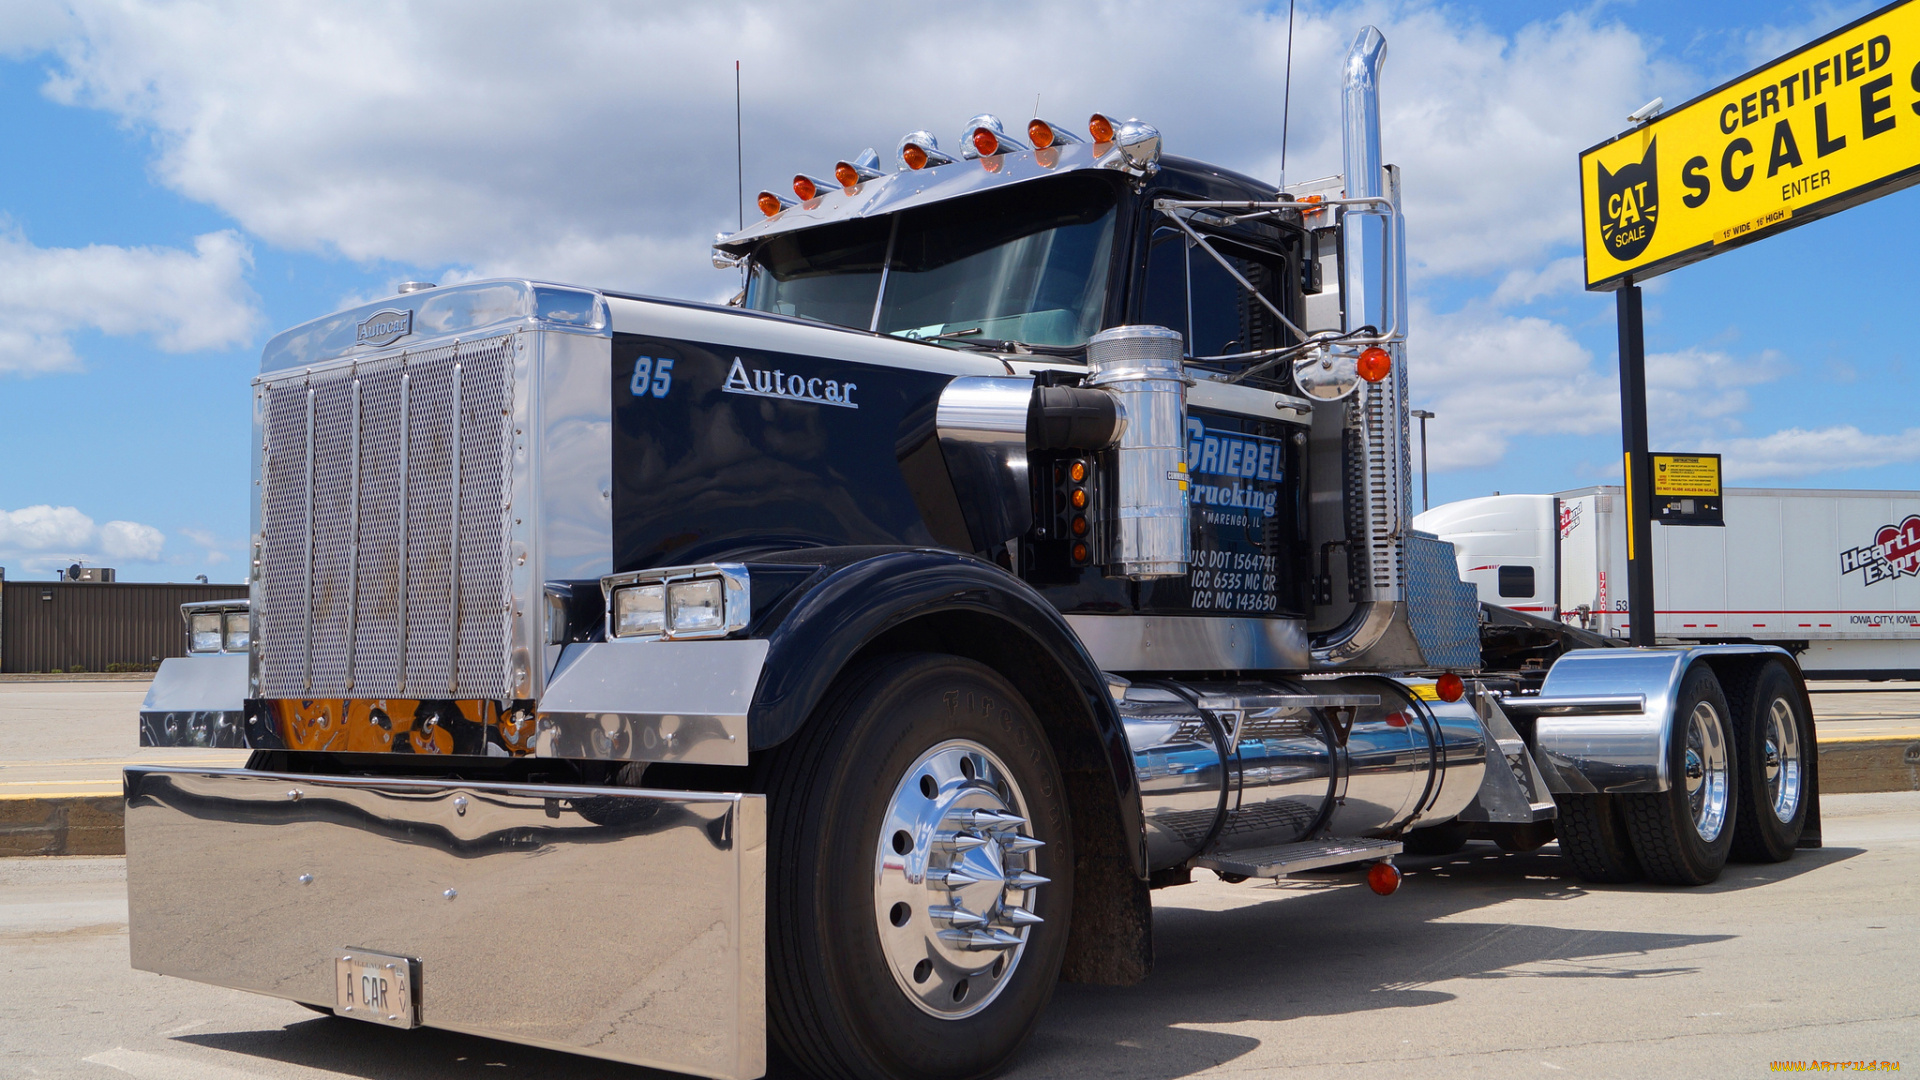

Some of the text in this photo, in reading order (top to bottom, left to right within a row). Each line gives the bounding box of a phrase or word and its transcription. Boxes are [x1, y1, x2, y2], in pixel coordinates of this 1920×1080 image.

[1719, 34, 1891, 135] CERTIFIED
[1782, 169, 1831, 202] ENTER
[1608, 181, 1648, 229] CAT
[1733, 222, 1751, 236] WIDE
[1765, 209, 1784, 223] HIGH
[1615, 225, 1646, 248] SCALE
[358, 318, 408, 341] Autocar
[630, 355, 675, 399] 85
[724, 356, 858, 405] Autocar
[1187, 416, 1283, 483] GRIEBEL
[1207, 512, 1260, 529] MARENGO, IL
[1191, 549, 1276, 572] US DOT 1564741
[1840, 526, 1920, 575] HeartL
[1191, 570, 1276, 591] ICC 6535 MC CR
[1191, 590, 1277, 611] ICC MC 143630
[1616, 600, 1628, 611] 53
[1850, 615, 1918, 626] IOWA CITY, IOWA
[347, 972, 389, 1010] A CAR
